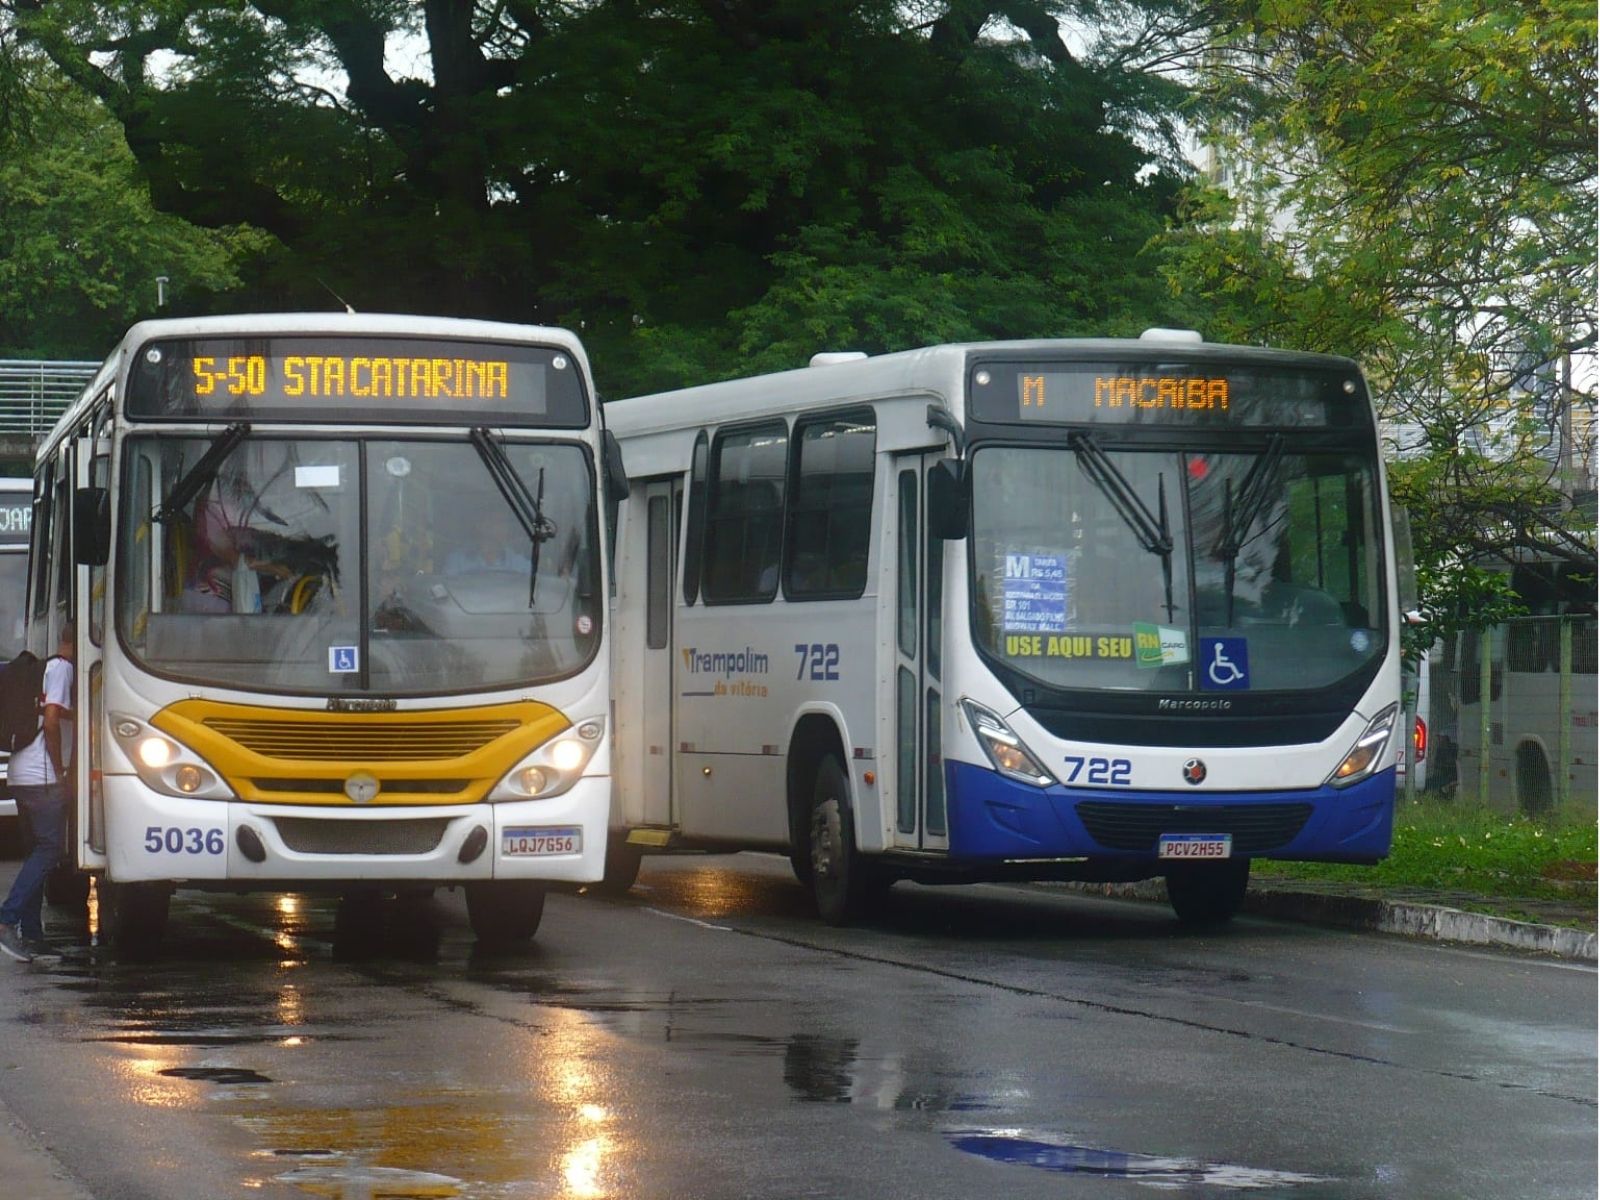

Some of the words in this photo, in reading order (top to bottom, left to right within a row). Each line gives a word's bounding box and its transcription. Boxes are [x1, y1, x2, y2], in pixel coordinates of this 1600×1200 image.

[1023, 376, 1044, 406] M
[1006, 556, 1030, 577] M
[1006, 636, 1041, 656] USE
[1047, 637, 1092, 658] AQUI
[1097, 638, 1132, 657] SEU
[1138, 633, 1159, 648] RN
[689, 646, 768, 679] Trampolim
[795, 643, 839, 680] 722
[1158, 699, 1232, 710] Marcopolo
[1064, 756, 1131, 785] 722
[145, 826, 224, 855] 5036
[1166, 842, 1224, 856] PCV2H55
